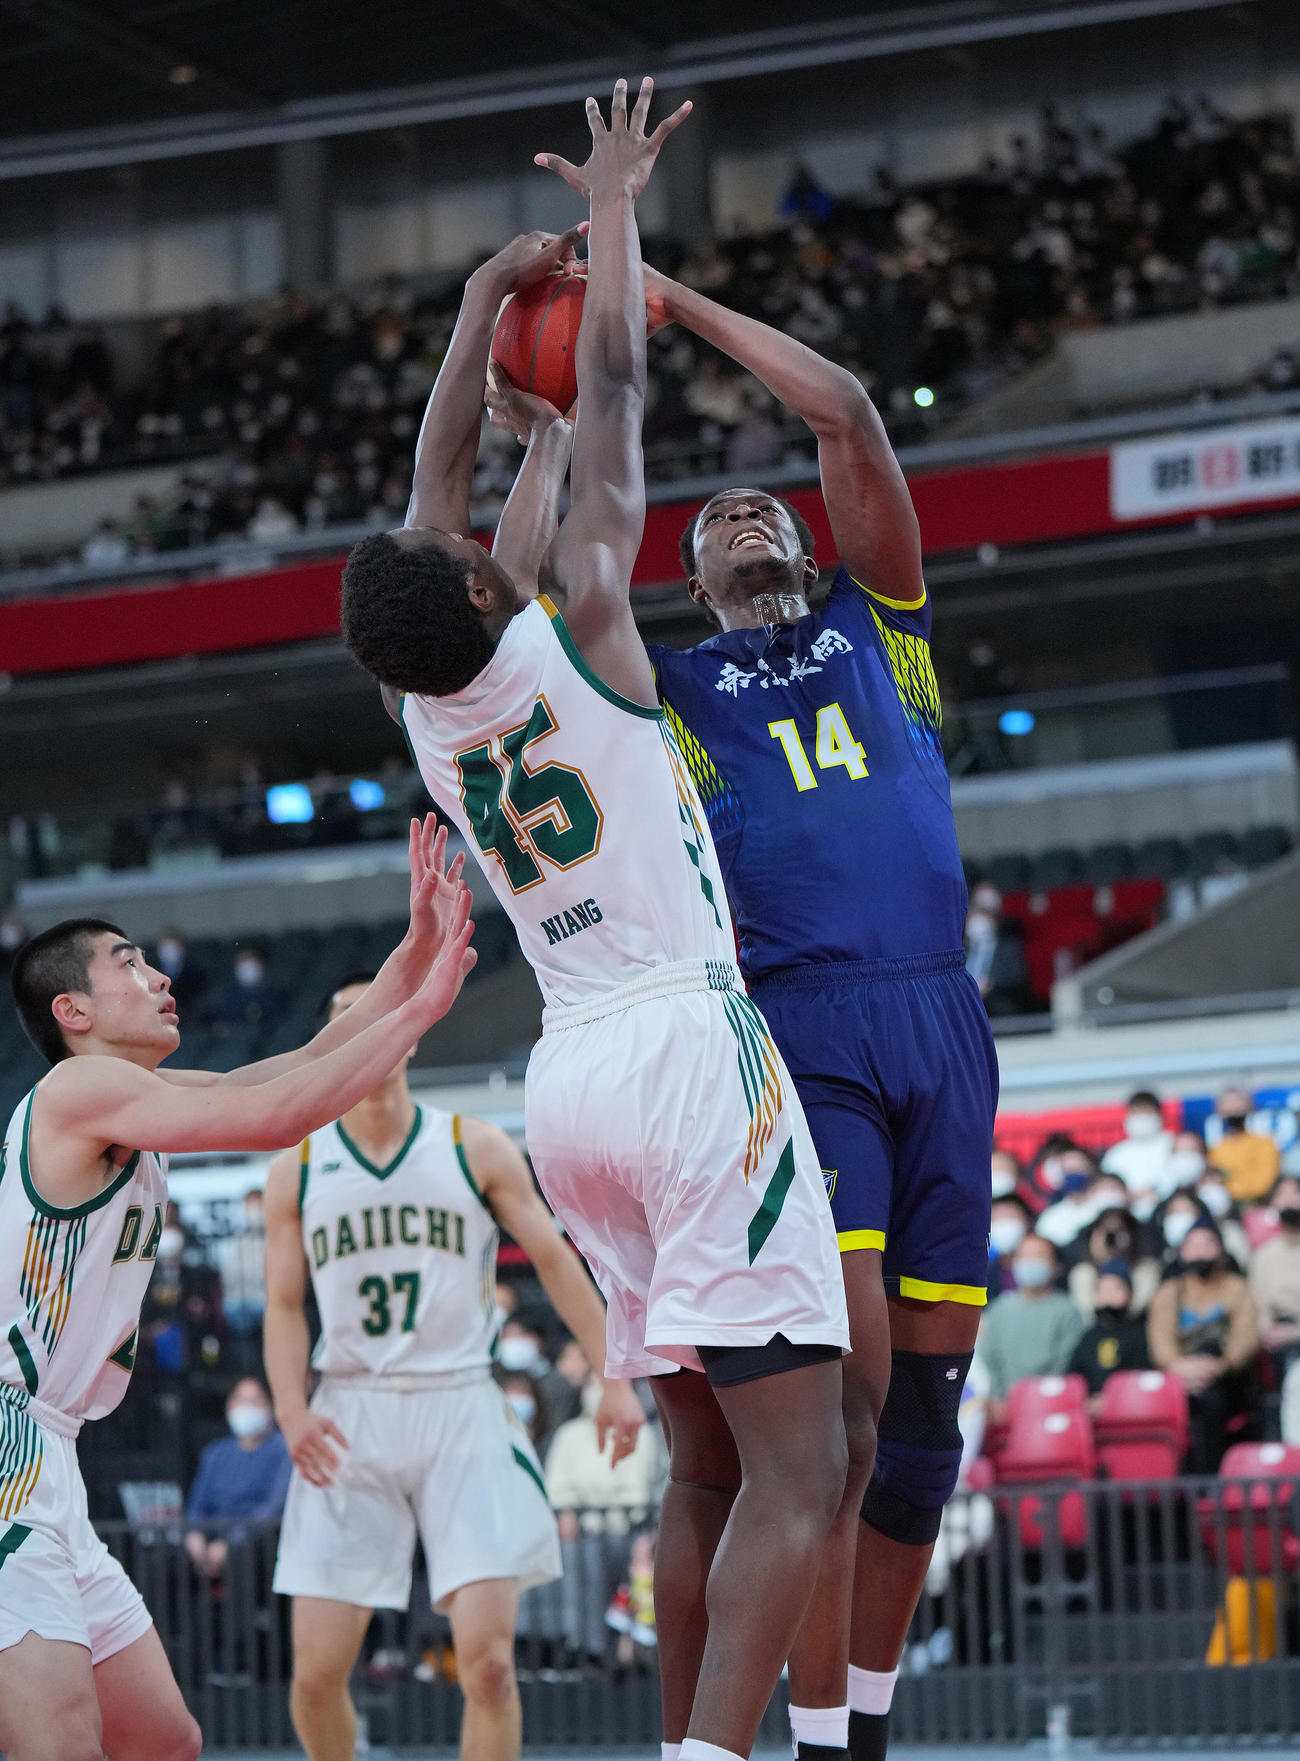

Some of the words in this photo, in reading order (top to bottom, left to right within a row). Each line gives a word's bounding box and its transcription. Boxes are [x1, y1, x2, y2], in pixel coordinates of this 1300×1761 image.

[767, 702, 869, 792] 14
[453, 692, 604, 896] 45
[540, 898, 603, 946] NIANG
[312, 1204, 466, 1270] DAIICHI
[358, 1270, 421, 1338] 37
